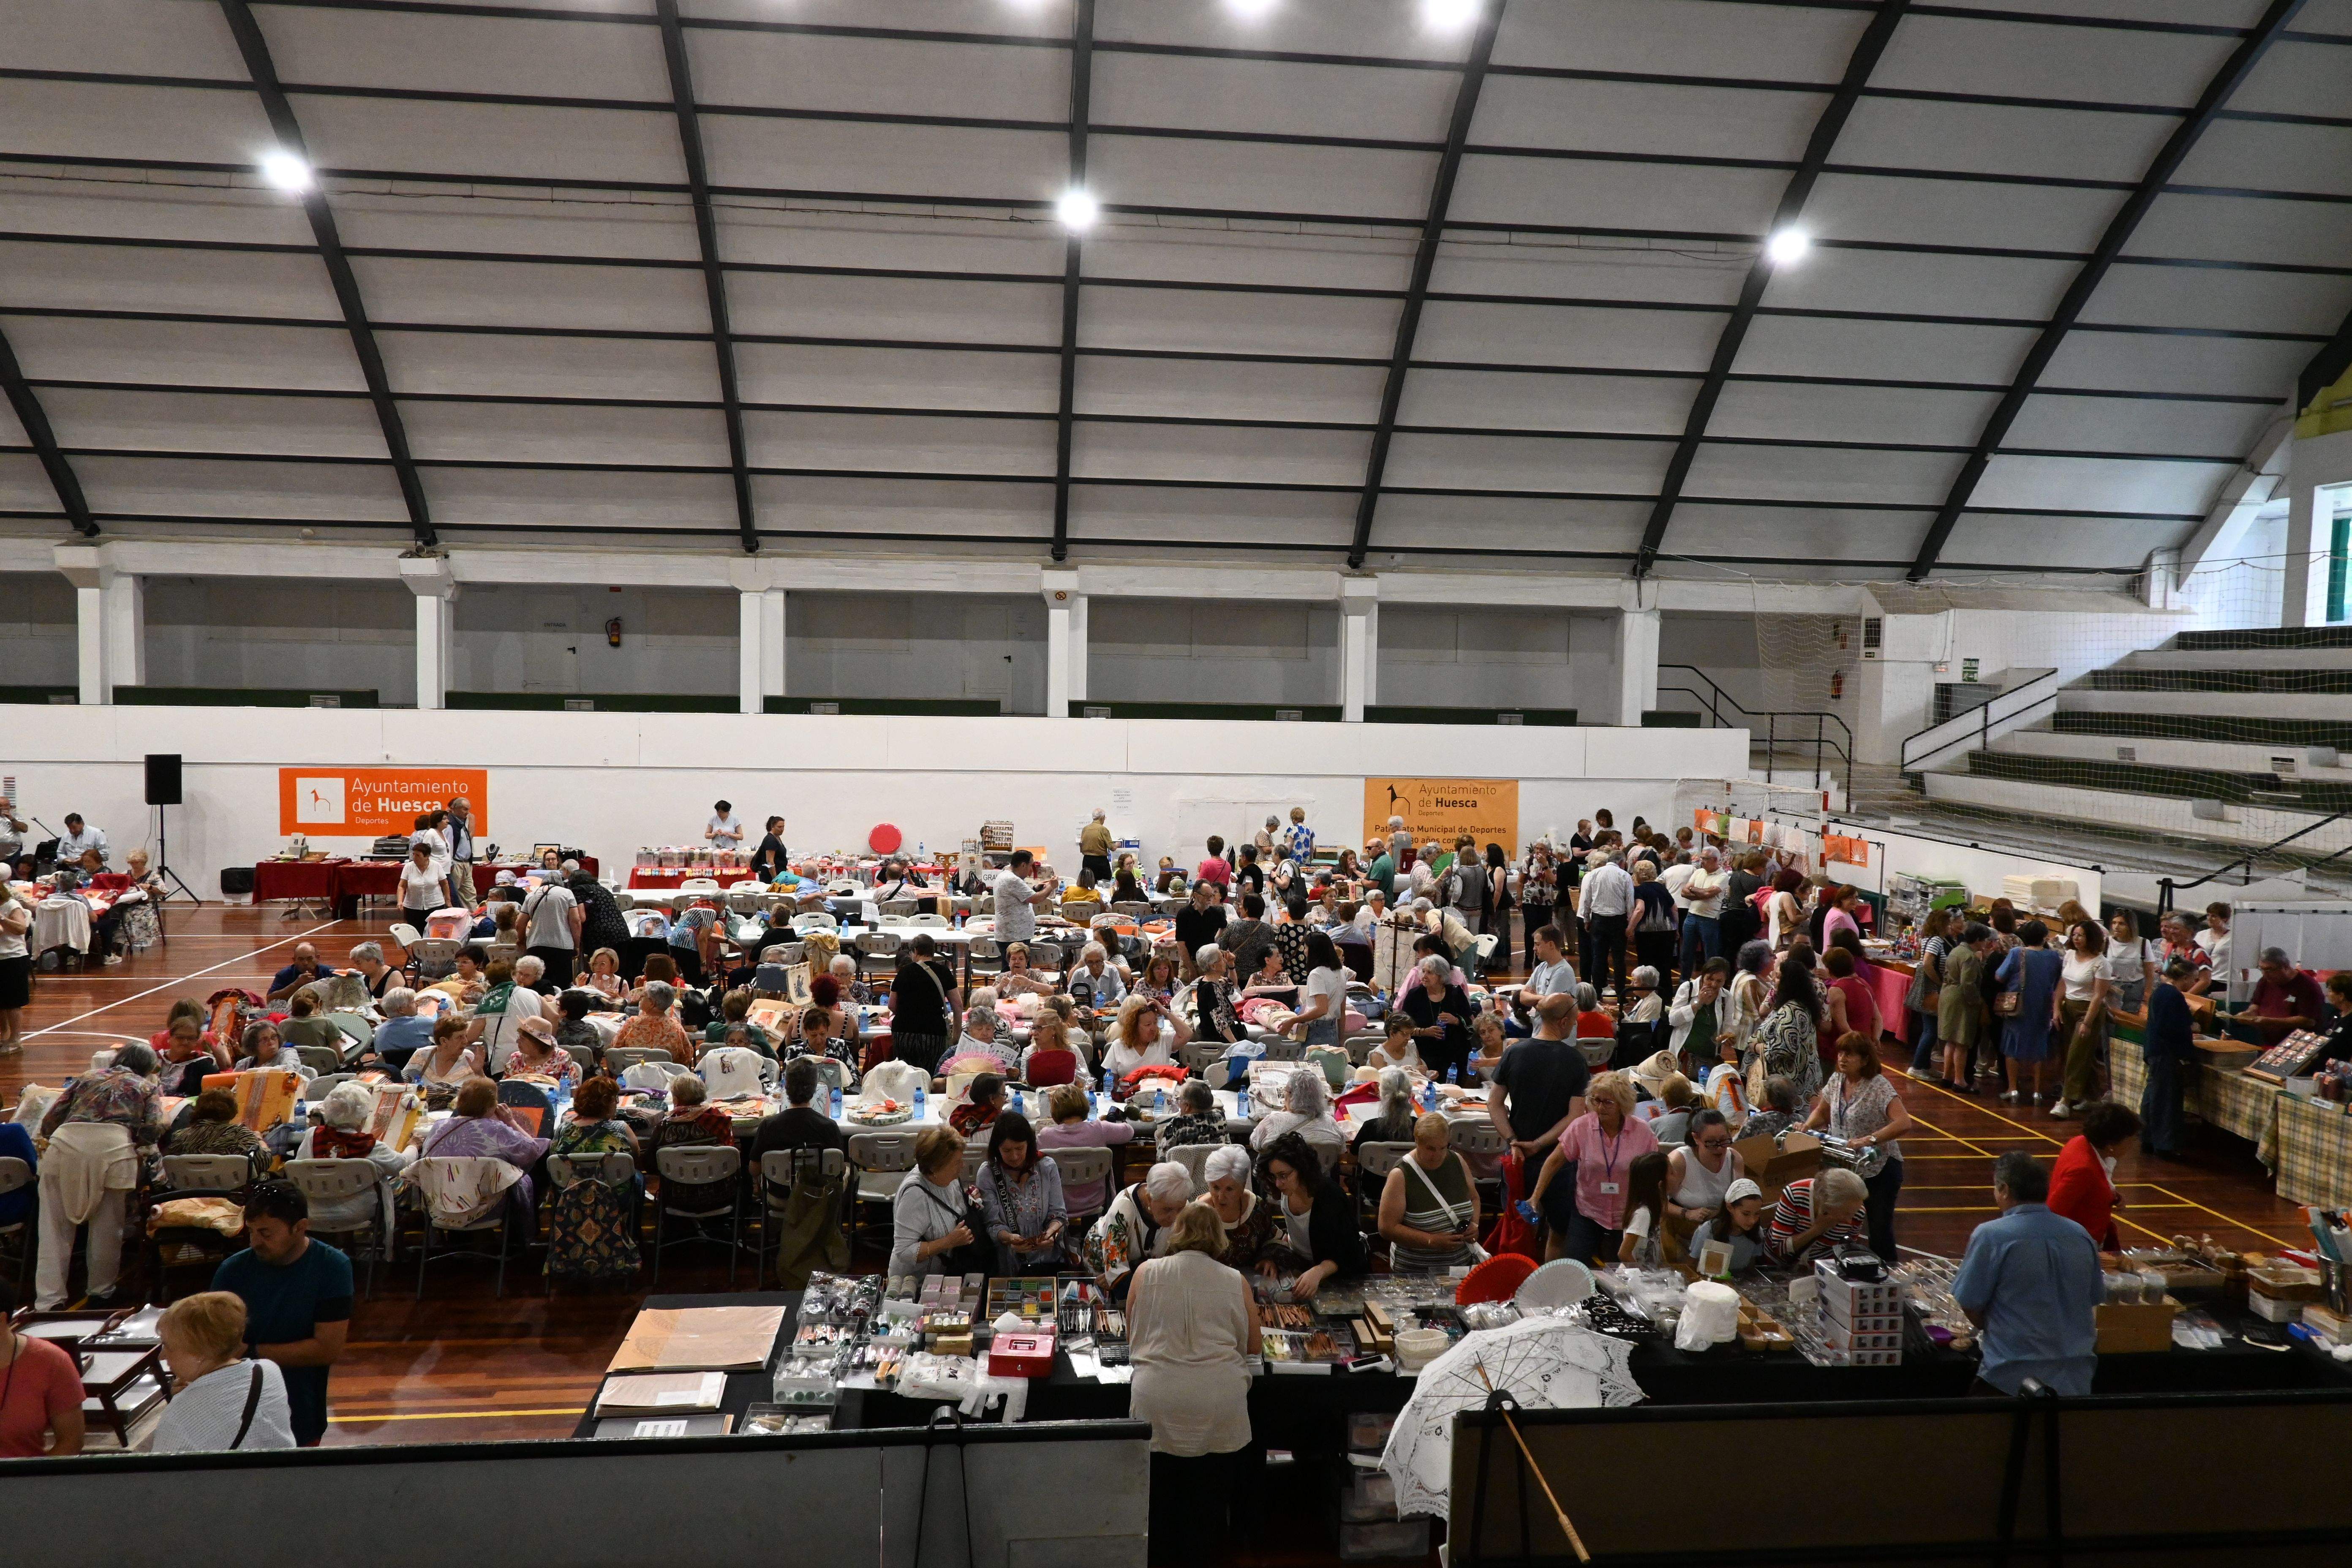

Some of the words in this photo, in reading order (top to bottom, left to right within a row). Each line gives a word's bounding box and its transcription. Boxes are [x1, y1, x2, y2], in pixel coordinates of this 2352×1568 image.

[351, 778, 468, 797] Ayuntamiento
[1419, 784, 1497, 796] Ayuntamiento
[352, 798, 371, 812] de
[378, 798, 442, 812] Huesca
[1418, 798, 1432, 807] de
[1435, 798, 1477, 808] Huesca
[355, 817, 389, 825] Deportes
[1417, 825, 1456, 834] Municipal
[1470, 826, 1507, 834] Deportes
